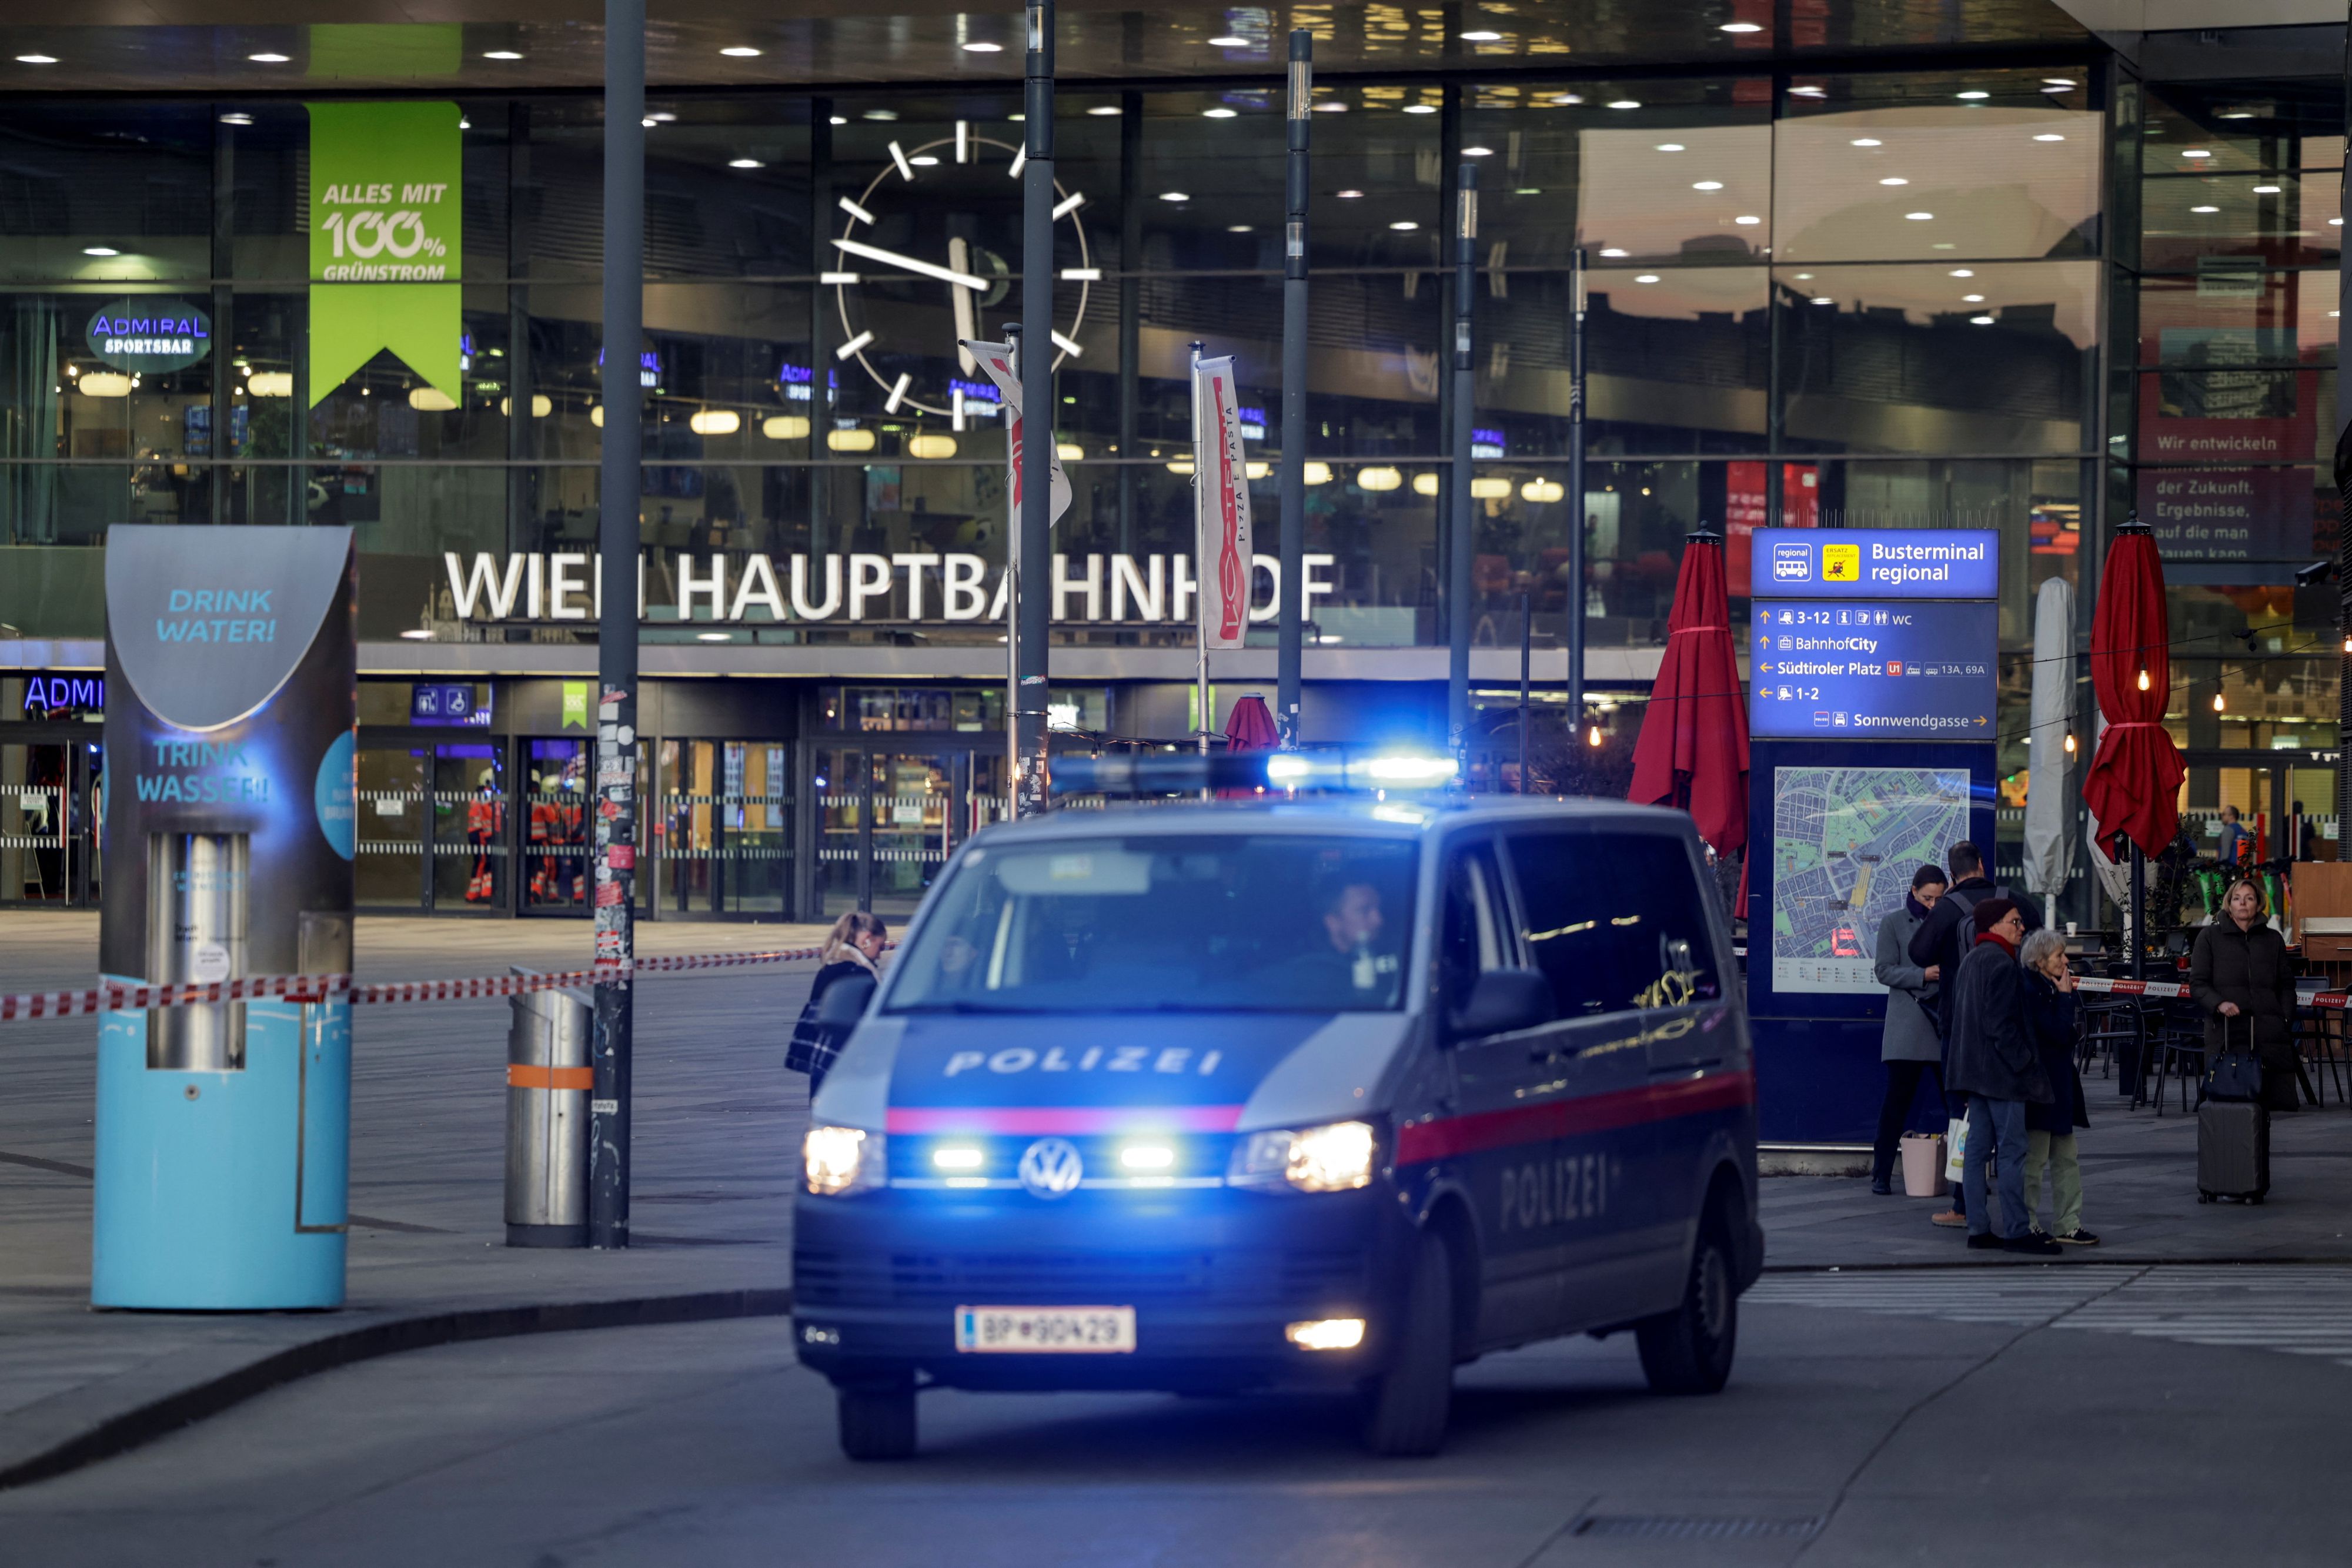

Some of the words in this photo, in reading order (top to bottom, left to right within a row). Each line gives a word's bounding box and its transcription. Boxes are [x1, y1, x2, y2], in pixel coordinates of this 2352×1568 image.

[322, 183, 393, 204] ALLES
[401, 183, 447, 203] MIT
[322, 210, 446, 259] 100%
[323, 261, 445, 281] GRÜNSTROM
[93, 315, 208, 337] ADMIRAL
[104, 339, 194, 354] SPORTSBAR
[1225, 407, 1237, 462] PASTA
[2157, 436, 2185, 450] Wir
[2190, 436, 2277, 450] entwickeln
[2156, 480, 2183, 494] der
[2188, 479, 2254, 494] Zukunft.
[1236, 492, 1245, 541] PIZZA
[2156, 502, 2250, 521] Ergebnisse,
[2156, 524, 2181, 539] auf
[2185, 524, 2210, 539] die
[2214, 527, 2249, 539] man
[1778, 549, 1808, 558] regional
[1872, 543, 1984, 560] Busterminal
[1872, 563, 1949, 584] regional
[169, 589, 273, 613] DRINK
[1797, 611, 1830, 624] 3-12
[1892, 615, 1912, 625] WC
[156, 618, 277, 643] WATER!
[1796, 637, 1877, 654] BahnhofCity
[1778, 661, 1845, 675] Südtiroler
[1849, 661, 1882, 675] Platz
[1889, 664, 1900, 673] U1
[1942, 665, 1963, 675] 13A,
[1966, 665, 1985, 674] 69A
[1796, 687, 1819, 700] 1-2
[1853, 713, 1969, 730] Sonnwendgasse
[152, 740, 249, 767] TRINK
[135, 773, 269, 803] WASSER!
[943, 1045, 1224, 1078] POLIZEI
[1500, 1152, 1607, 1233] POLIZEI
